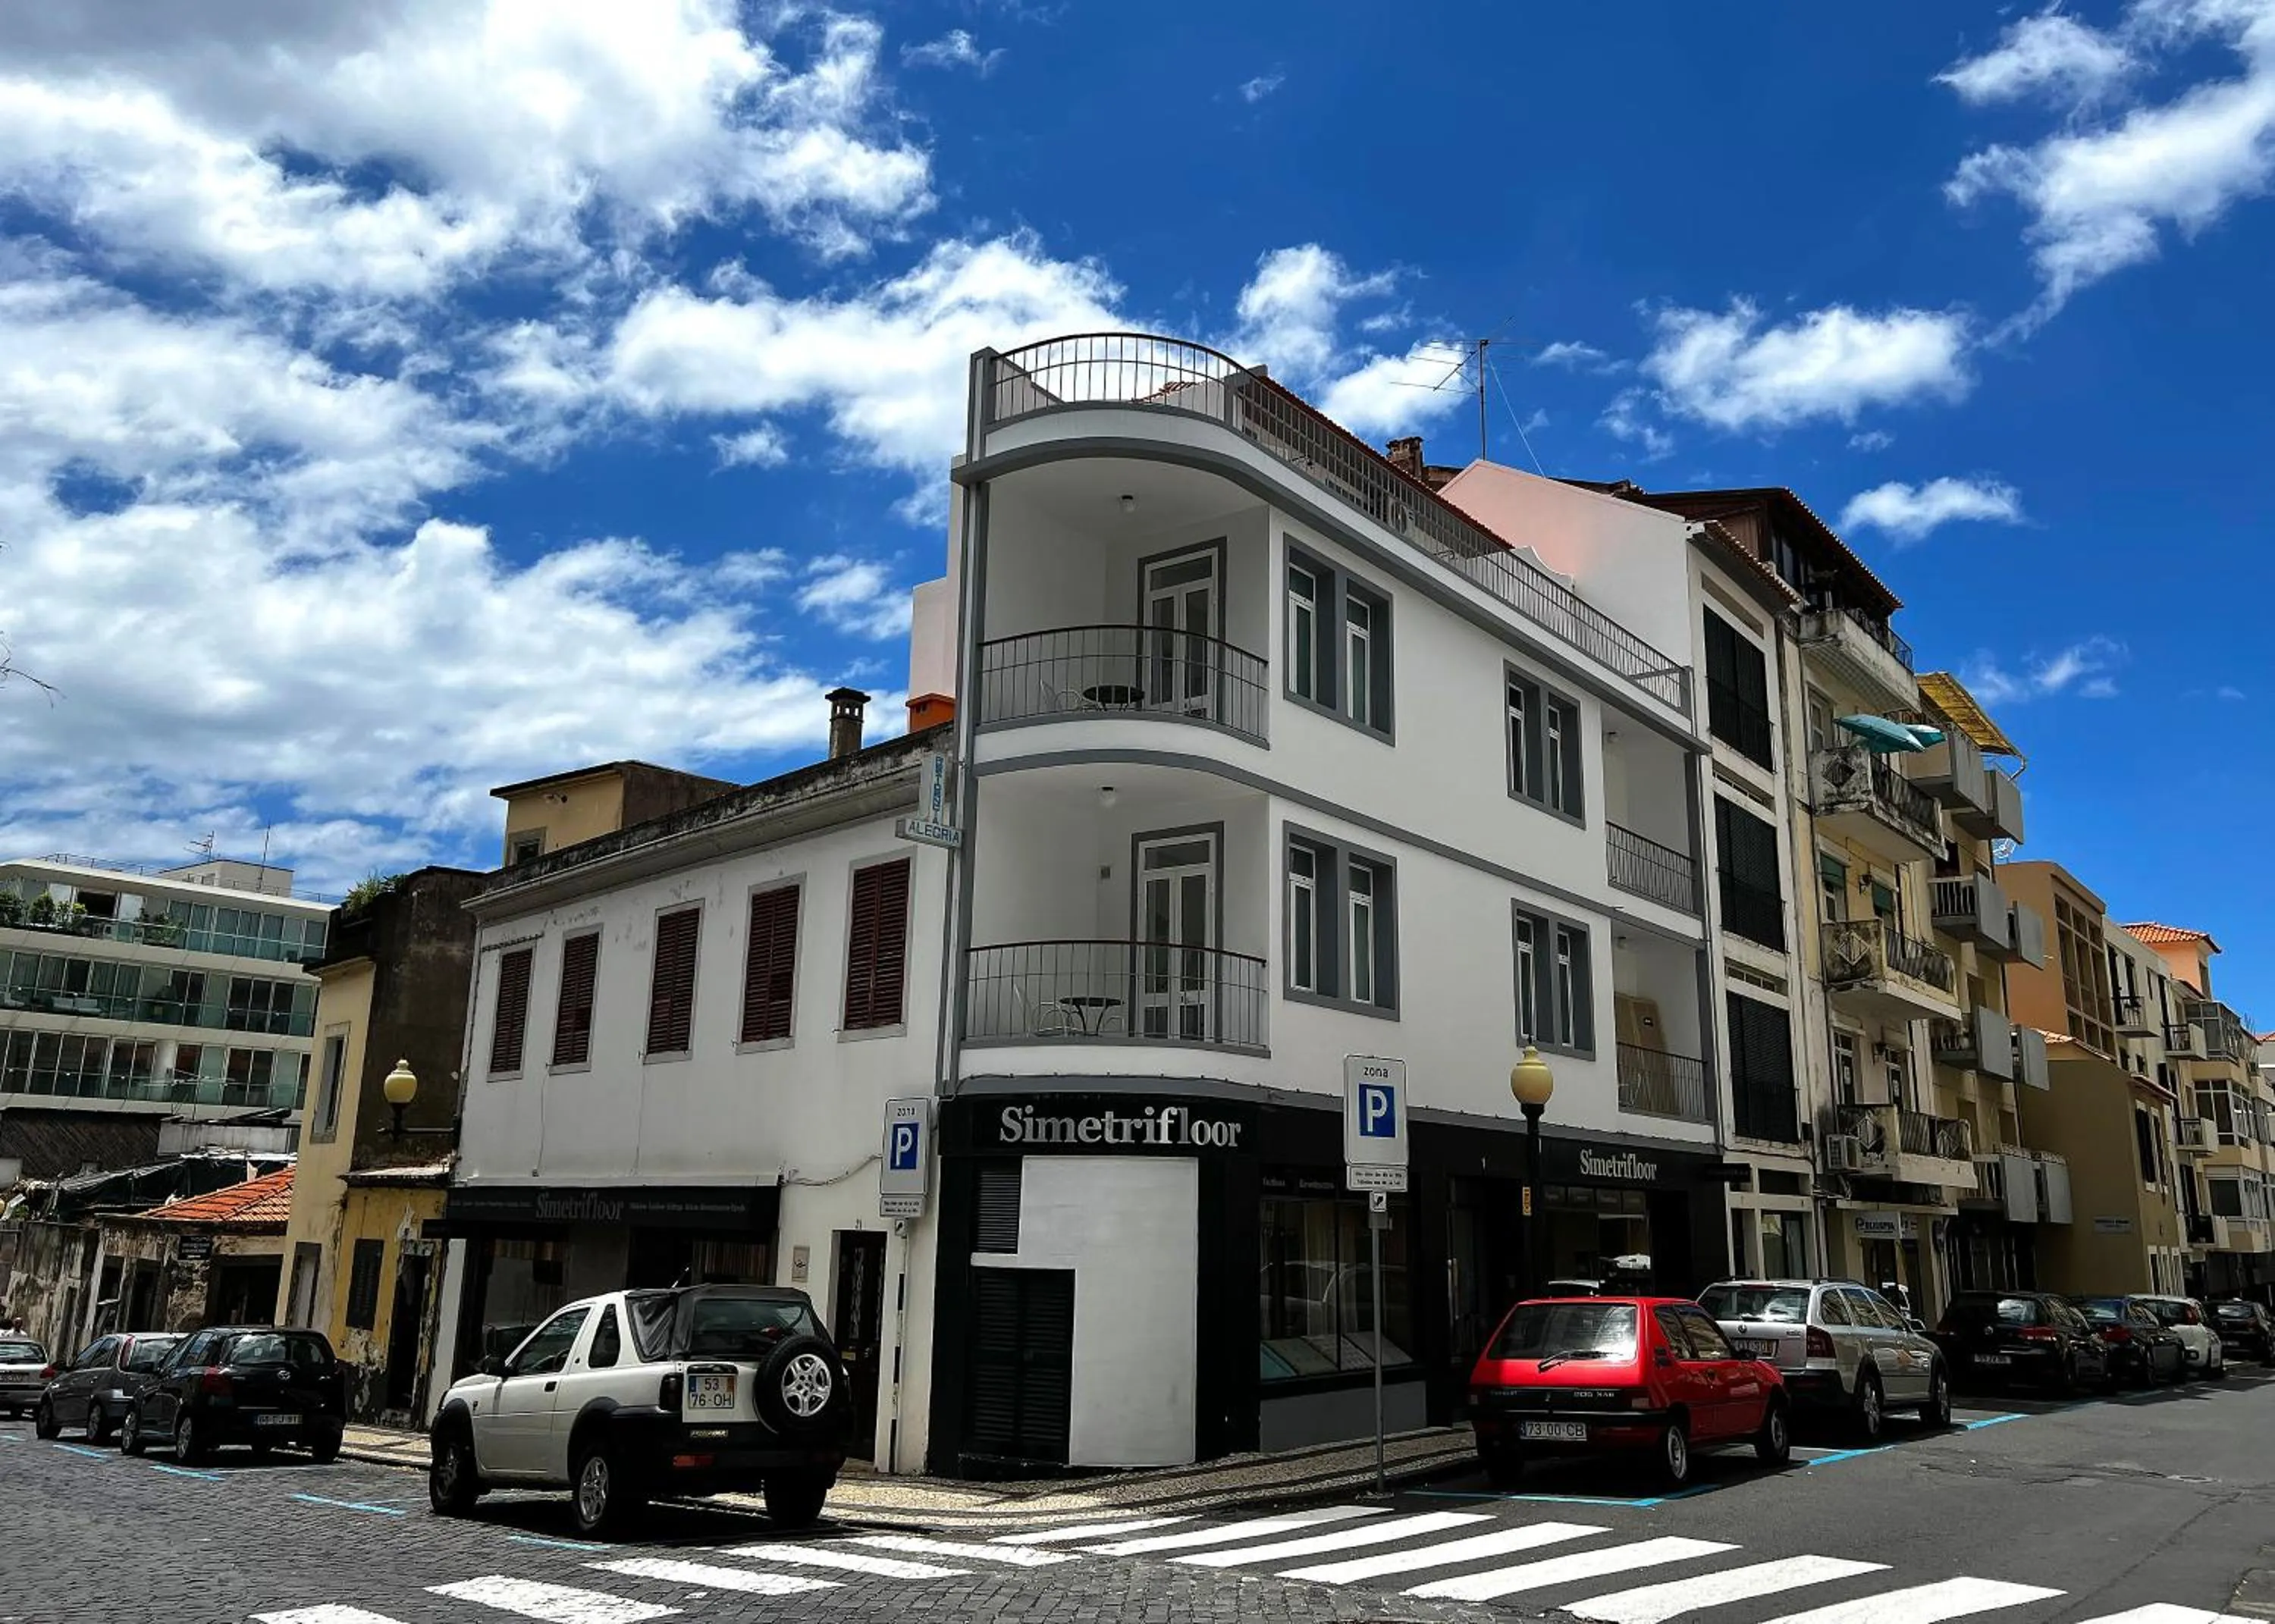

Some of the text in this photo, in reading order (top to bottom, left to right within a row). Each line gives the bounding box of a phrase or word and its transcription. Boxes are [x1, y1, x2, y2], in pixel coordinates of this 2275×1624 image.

[908, 822, 959, 843] ALEGRIA
[1363, 1066, 1389, 1078] zona
[1366, 1088, 1388, 1132] P
[999, 1105, 1242, 1147] Simetrifloor
[896, 1127, 912, 1167] P
[1580, 1149, 1657, 1180] Simetrifloor
[535, 1192, 624, 1221] Simetrifloor
[704, 1378, 720, 1391] 53
